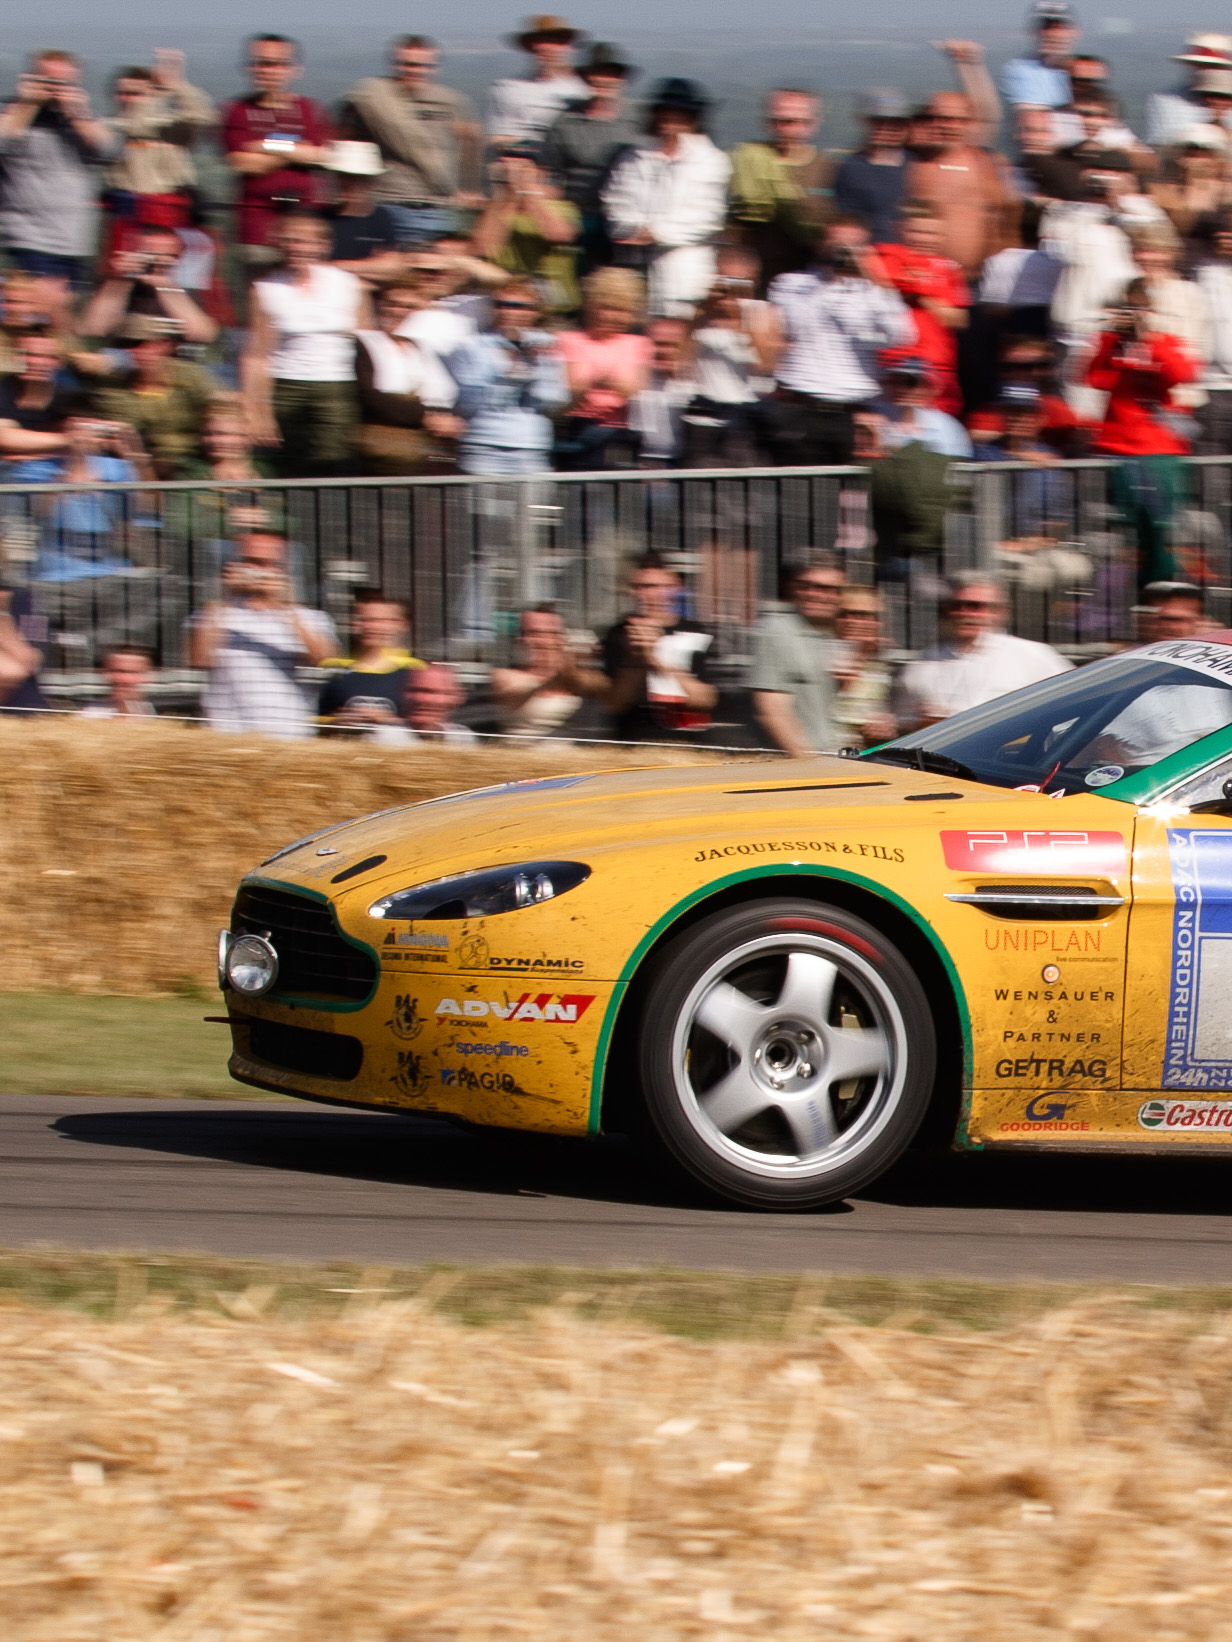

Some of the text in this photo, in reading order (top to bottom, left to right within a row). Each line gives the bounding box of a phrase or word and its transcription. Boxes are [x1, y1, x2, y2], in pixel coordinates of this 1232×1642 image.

[694, 841, 905, 863] JACQUESSON & FILS
[1171, 832, 1196, 903] ADAC
[984, 928, 1101, 952] UNIPLAN
[995, 989, 1115, 1001] WENSAUER
[1167, 910, 1194, 1065] NORDRHEIN
[434, 998, 578, 1021] ADVAN
[1046, 1010, 1058, 1023] &
[1003, 1031, 1101, 1042] PARTNER
[456, 1041, 530, 1057] speedline
[995, 1058, 1107, 1078] GETRAG
[1166, 1067, 1209, 1087] 24h
[1000, 1122, 1090, 1132] GOODRIDGE
